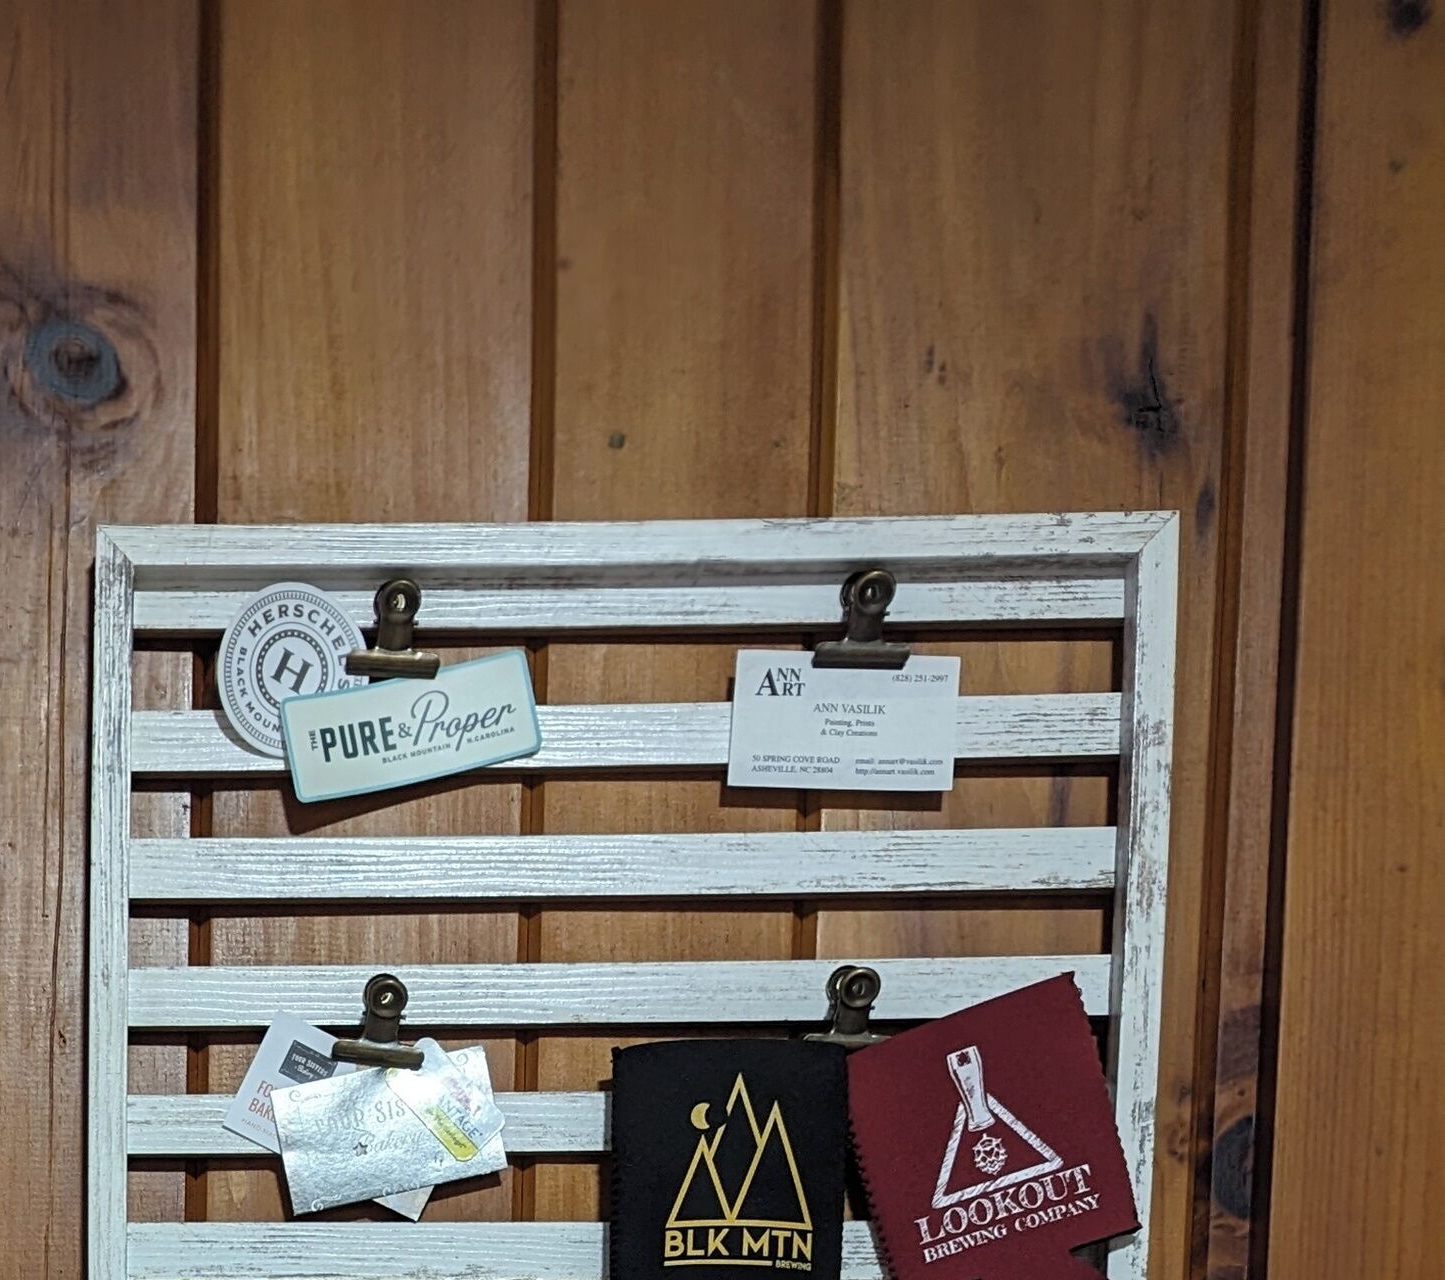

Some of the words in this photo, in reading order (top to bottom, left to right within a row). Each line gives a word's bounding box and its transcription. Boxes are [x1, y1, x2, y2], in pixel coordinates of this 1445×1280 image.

[236, 647, 248, 698] BLACK
[270, 647, 314, 695] H
[813, 703, 839, 713] ANN
[841, 703, 887, 715] VASILIK
[319, 716, 397, 763] PURE
[398, 723, 413, 739] &
[410, 690, 517, 752] Proper
[820, 728, 827, 736] &
[829, 728, 844, 738] Clay
[846, 728, 879, 737] Creations
[855, 718, 875, 727] Prints
[308, 730, 318, 751] THE
[382, 753, 408, 764] BLACK
[410, 743, 451, 758] MOUNTAIN
[762, 755, 791, 763] SPRING
[793, 755, 815, 764] COVE
[816, 756, 841, 764] ROAD
[799, 766, 812, 774] NC
[913, 1163, 1092, 1246] LOOKOUT
[922, 1223, 1008, 1264] BREWING
[1014, 1193, 1101, 1232] COMPANY
[664, 1228, 730, 1258] BLK
[741, 1227, 813, 1262] MTN
[775, 1259, 812, 1272] BREWING
